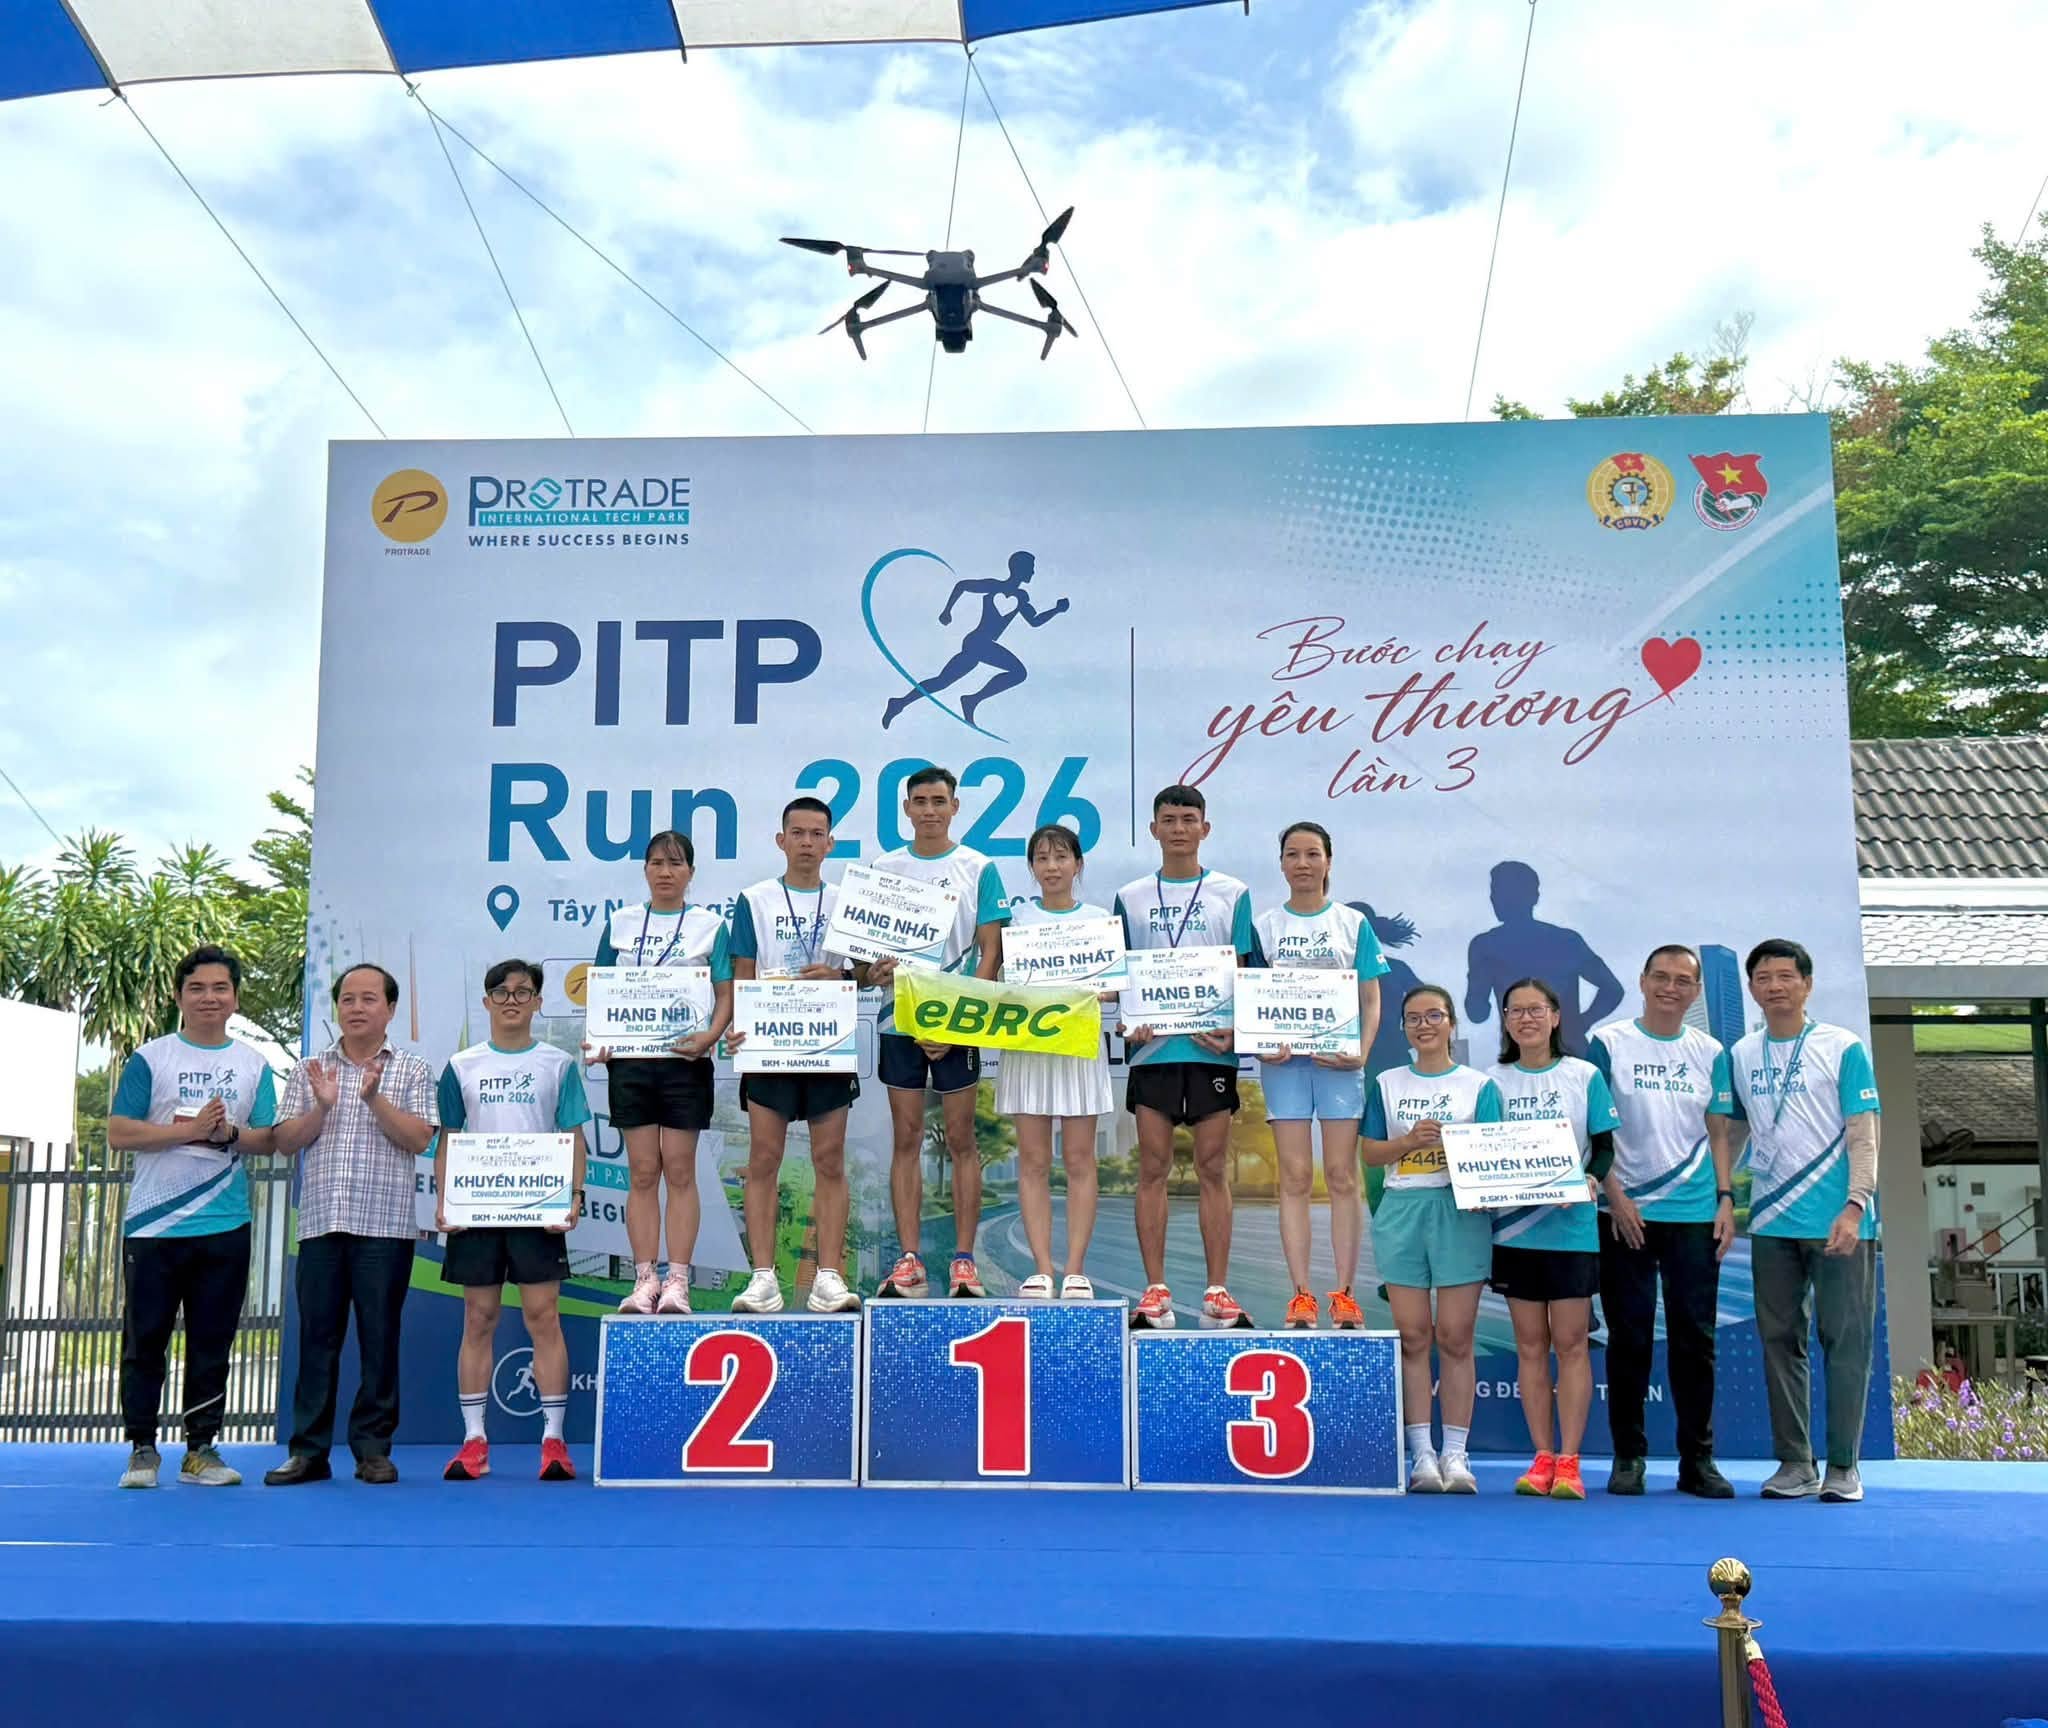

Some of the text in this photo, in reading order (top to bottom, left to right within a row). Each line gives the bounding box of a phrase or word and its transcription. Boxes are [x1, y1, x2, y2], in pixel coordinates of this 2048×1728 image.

[482, 511, 685, 523] INTERNATIONAL TECH PARK
[468, 533, 689, 547] WHERE SUCCESS BEGINS
[385, 548, 431, 556] PROTRADE
[1256, 616, 1557, 689] Bước chạy
[492, 619, 823, 726] PITP
[1177, 671, 1660, 787] yêu thương
[1327, 746, 1479, 799] lần 3
[488, 756, 1101, 862] Run 2026
[548, 899, 597, 927] Tây
[776, 916, 807, 927] PITP
[843, 905, 939, 942] HẠNG NHẤT
[633, 935, 663, 946] PTP
[1278, 936, 1309, 947] PITP
[657, 947, 685, 957] 226
[1016, 948, 1115, 972] HẠNG NHẤT
[1278, 947, 1334, 958] Run 2026
[1141, 986, 1190, 1002] HẠNG
[607, 1007, 656, 1024] HẠNG
[915, 996, 1070, 1038] eBRC
[1257, 1006, 1307, 1022] HẠNG
[754, 1020, 838, 1038] HẠNG NHÌ
[793, 1039, 820, 1047] PLACE
[178, 1072, 212, 1084] PITP
[1634, 1064, 1666, 1077] PITP
[479, 1077, 512, 1090] PITP
[1634, 1077, 1694, 1093] Run 2026
[179, 1086, 238, 1100] Run 2026
[479, 1091, 536, 1104] Run 2026
[1398, 1098, 1430, 1109] PITP
[1508, 1096, 1538, 1109] PITP
[1397, 1111, 1453, 1120] Run 2026
[1508, 1109, 1564, 1121] Run 2026
[1457, 1155, 1573, 1173] KHUYẾN KHÍCH
[454, 1172, 515, 1188] KHUYẾN
[519, 1173, 564, 1188] KHÍCH
[683, 1329, 777, 1472] 2
[948, 1316, 1031, 1477] 1
[1225, 1347, 1314, 1480] 3
